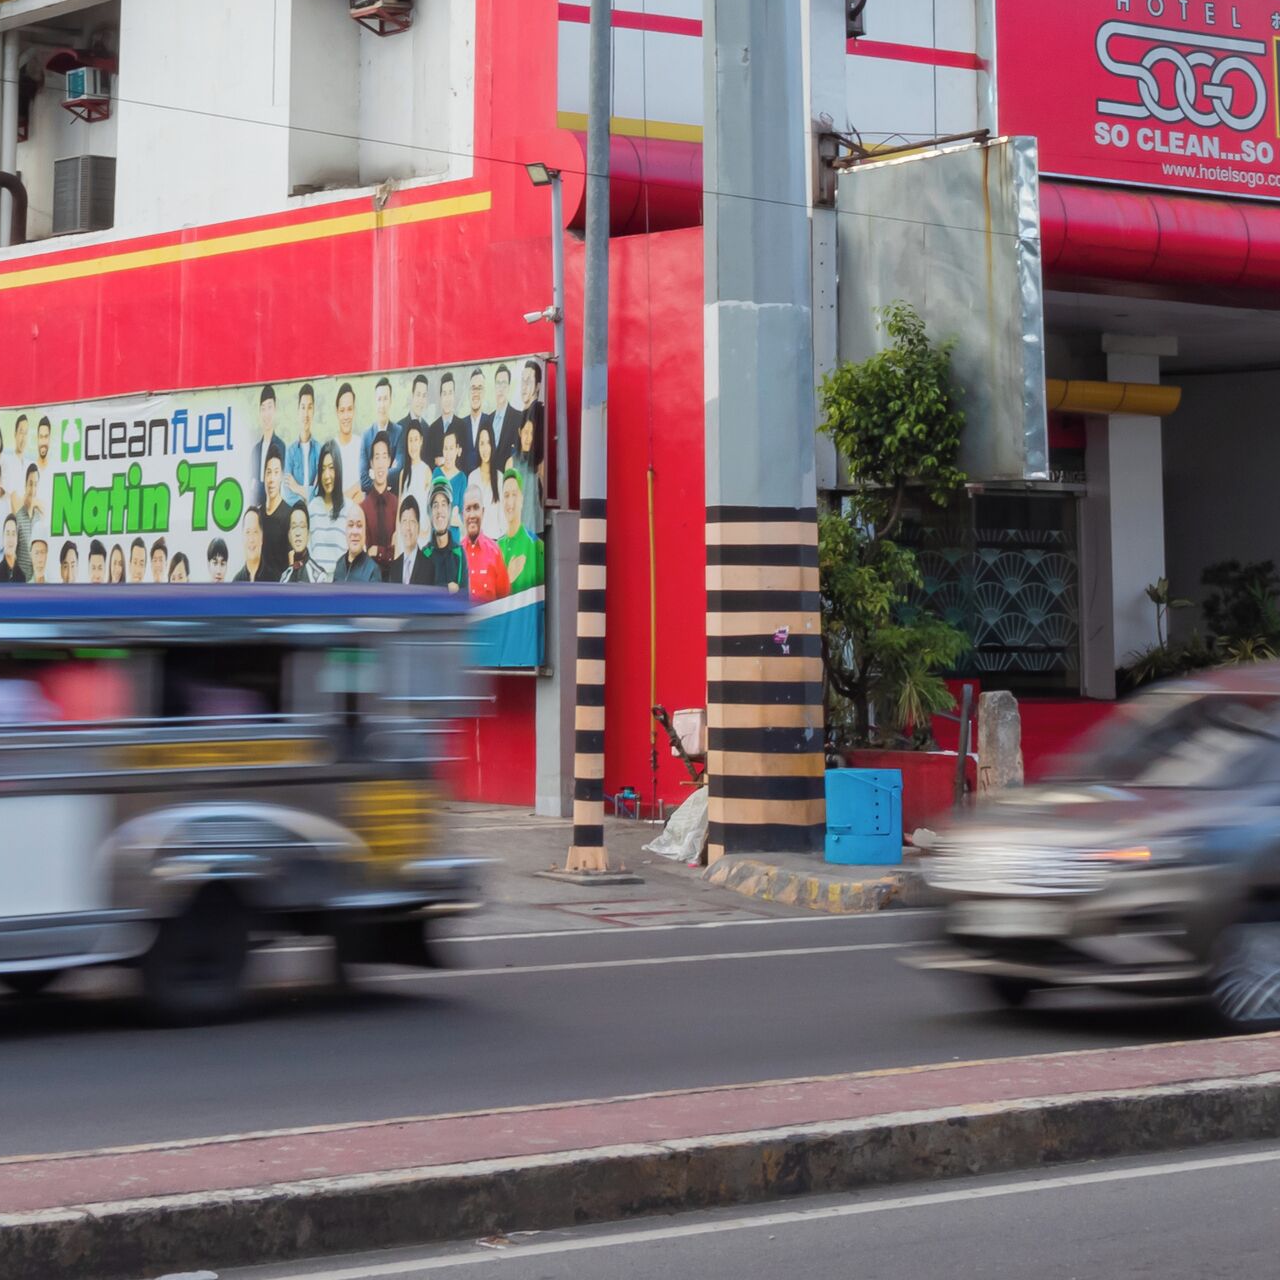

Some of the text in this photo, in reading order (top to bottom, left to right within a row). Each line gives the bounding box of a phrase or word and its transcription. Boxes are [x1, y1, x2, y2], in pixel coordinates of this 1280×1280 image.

[1095, 19, 1267, 132] SOGO
[1094, 122, 1130, 148] SO
[84, 407, 234, 461] cleanfuel
[50, 463, 173, 538] Natin
